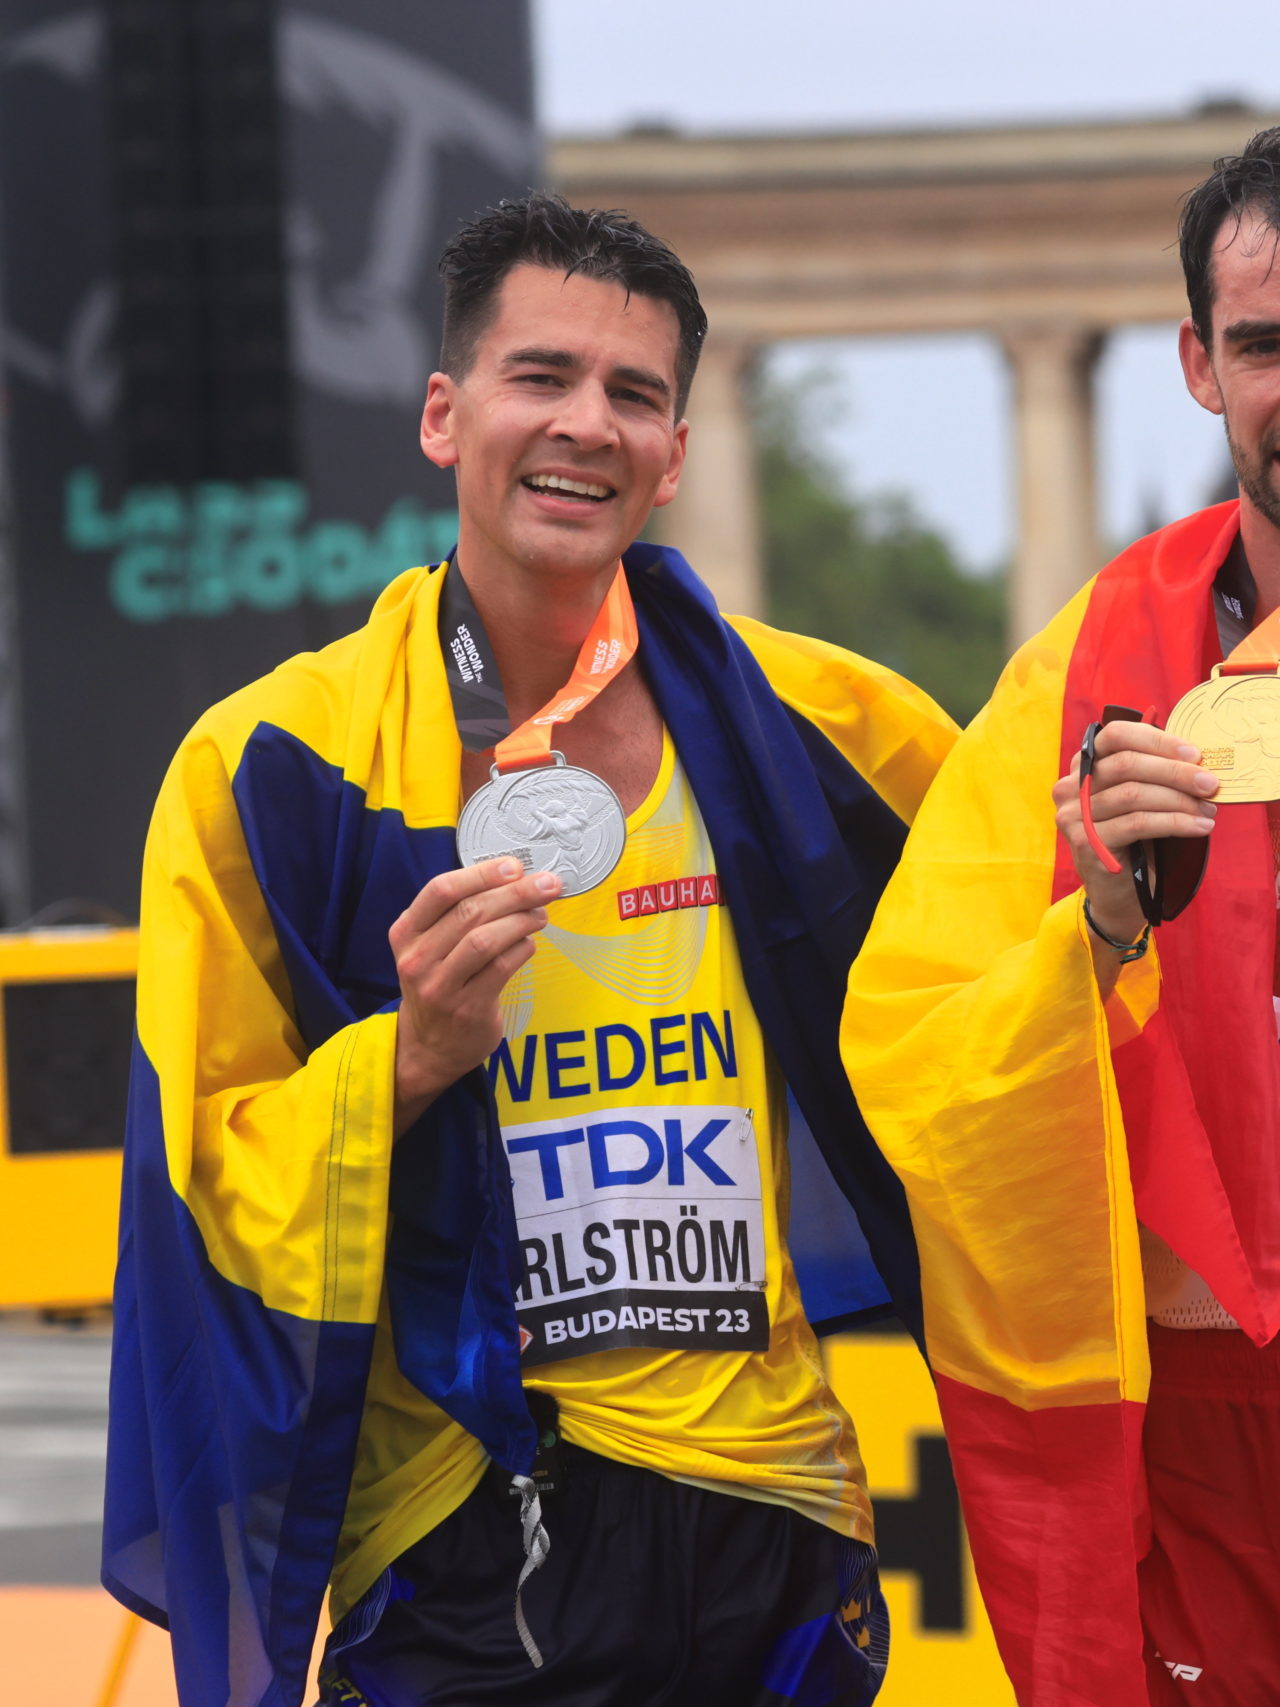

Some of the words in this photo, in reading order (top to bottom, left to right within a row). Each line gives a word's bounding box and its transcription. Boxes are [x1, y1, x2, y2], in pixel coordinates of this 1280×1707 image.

[450, 637, 475, 683] WITNESS
[456, 623, 485, 673] WONDER
[620, 879, 715, 915] BAUHA
[486, 1009, 738, 1103] WEDEN
[506, 1118, 738, 1201] TDK
[515, 1204, 752, 1303] RLSTRÖM
[544, 1305, 711, 1345] BUDAPEST
[715, 1308, 751, 1334] 23
